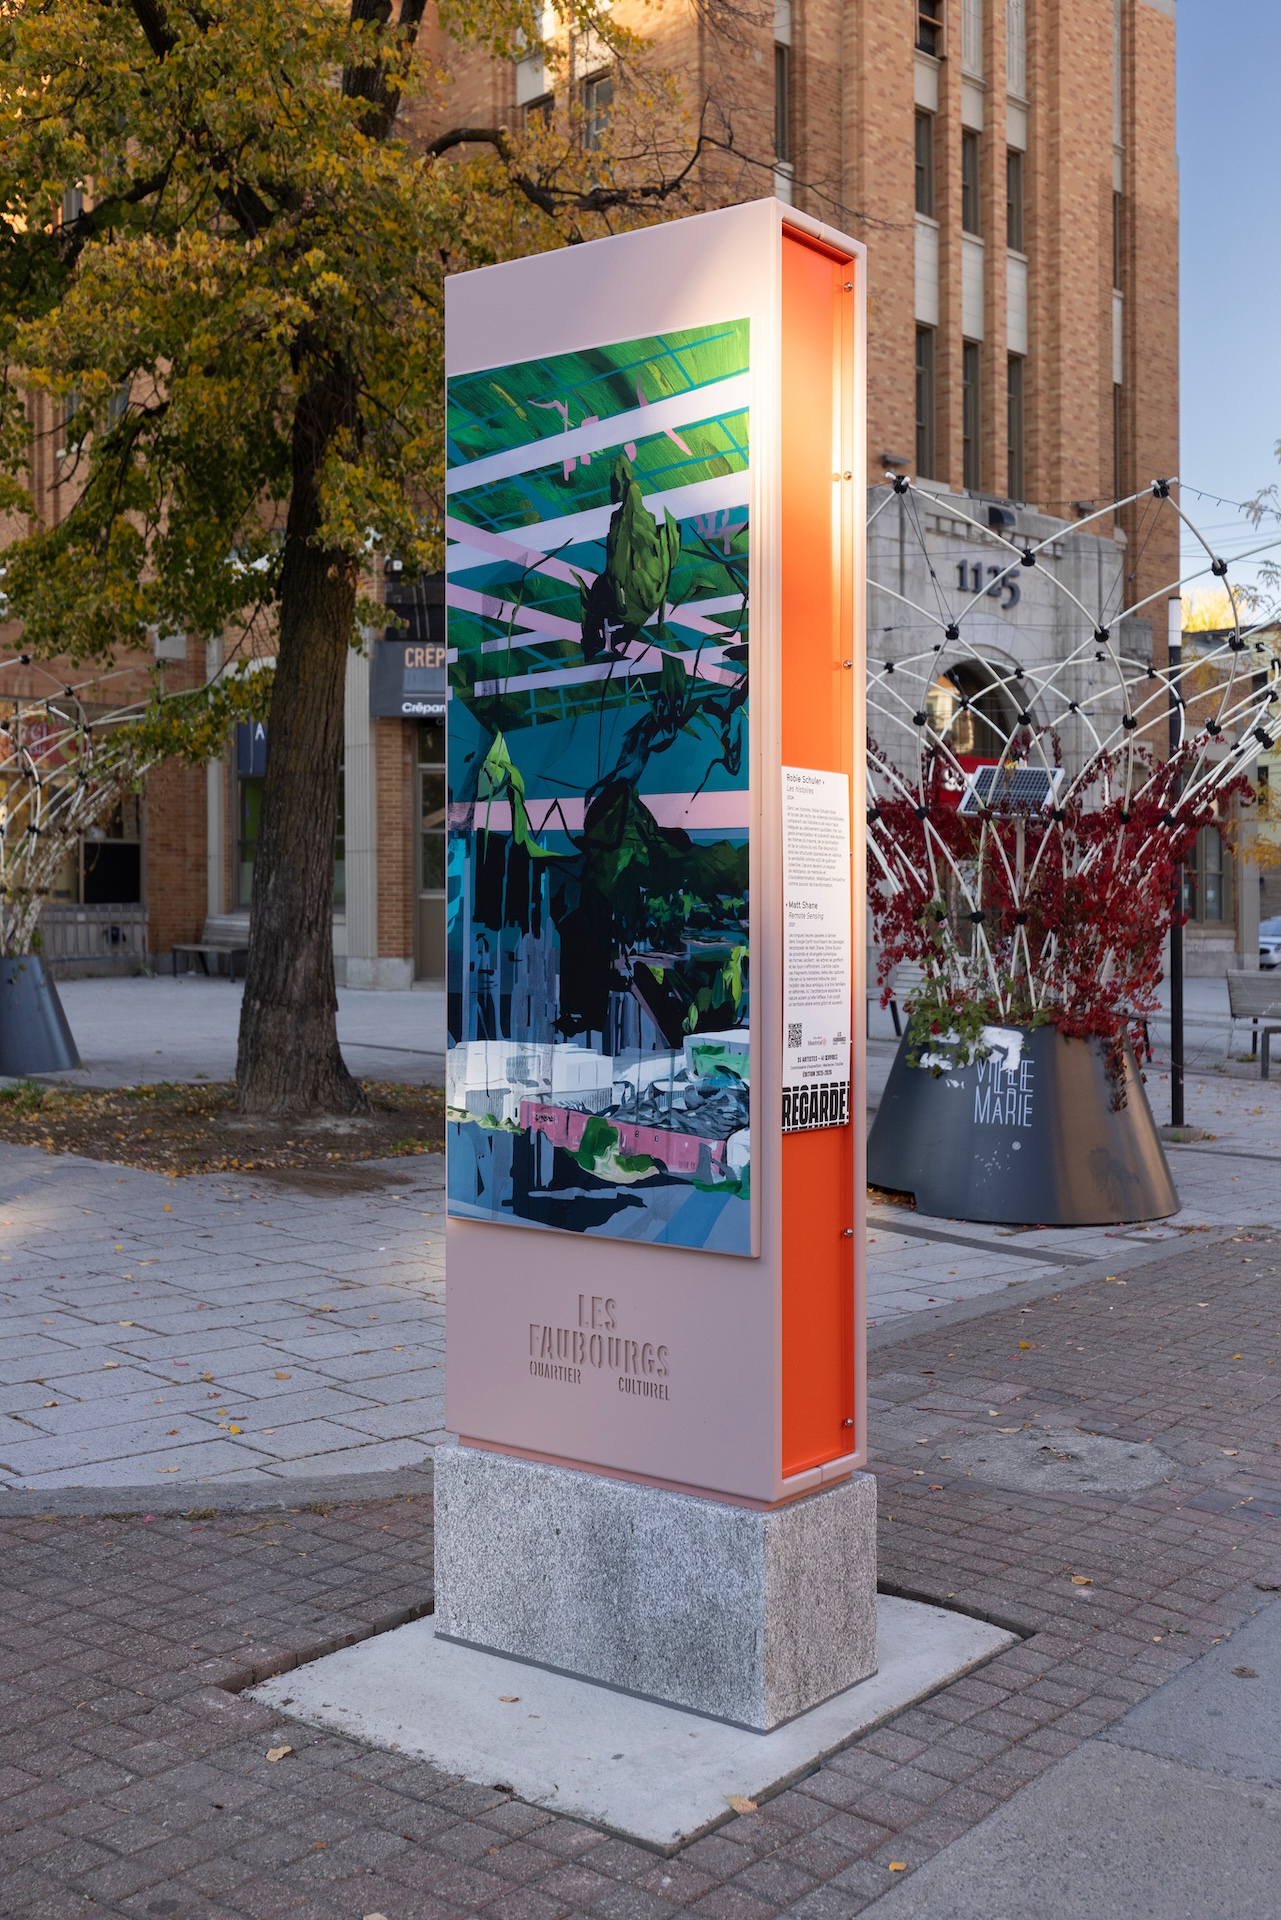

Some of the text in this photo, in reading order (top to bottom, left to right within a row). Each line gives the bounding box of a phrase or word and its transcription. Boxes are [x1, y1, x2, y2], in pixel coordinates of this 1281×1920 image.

[956, 558, 1020, 609] 1125
[404, 643, 445, 668] CRÊP
[787, 774, 821, 785] Robie Schuler
[796, 786, 814, 794] histoires
[789, 901, 818, 909] Matt Shane
[807, 912, 824, 920] Sensing
[974, 1085, 1034, 1127] MARIE
[578, 1294, 616, 1332] LES
[530, 1324, 670, 1379] FAUBOURGS
[530, 1360, 670, 1401] QUARTIER CULTUREL
